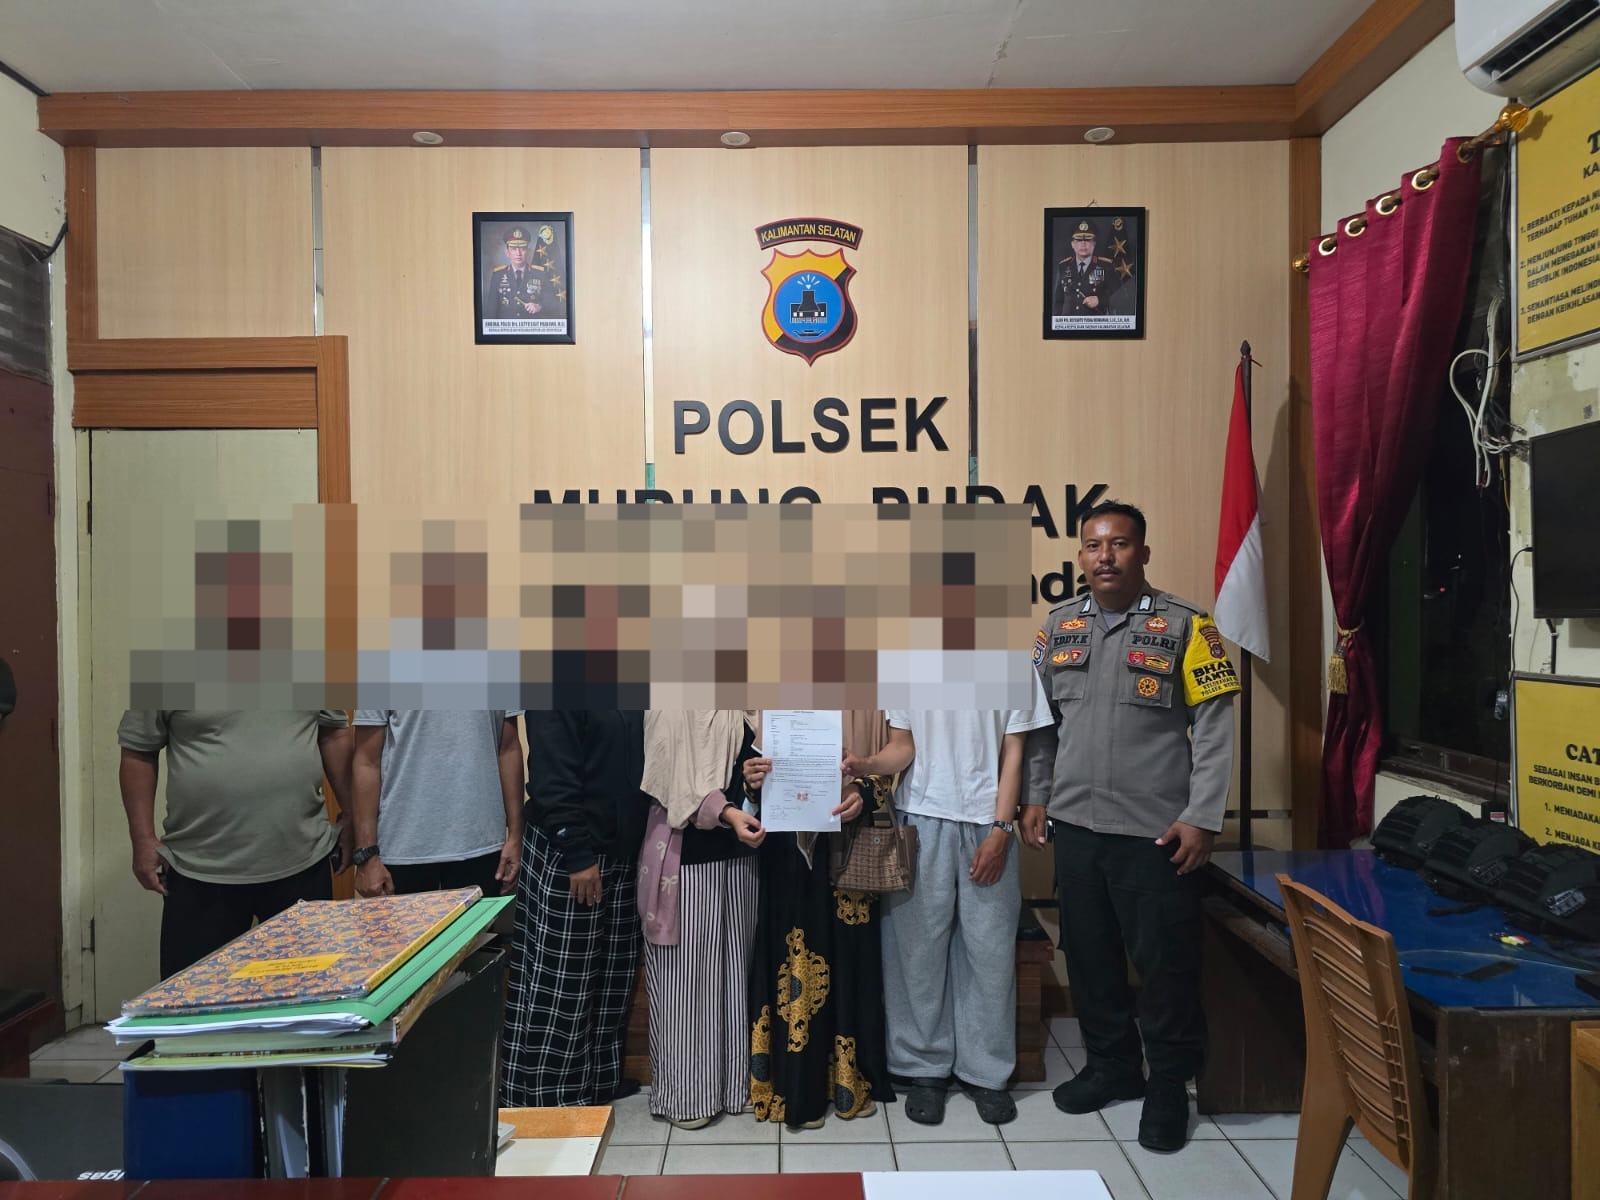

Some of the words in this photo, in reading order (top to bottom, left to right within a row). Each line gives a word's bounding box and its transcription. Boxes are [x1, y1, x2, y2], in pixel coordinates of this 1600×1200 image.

[1527, 208, 1560, 231] BERBAKTI
[1562, 194, 1590, 214] KEPADA
[761, 224, 816, 243] KALIMANTAN
[817, 224, 857, 242] SELATAN
[1527, 219, 1563, 242] TERHADAP
[1563, 208, 1588, 226] TUHAN
[1527, 239, 1573, 266] MENJUNJUNG
[1574, 228, 1598, 246] TINGGI
[1527, 261, 1551, 277] DALAM
[1527, 269, 1560, 289] REPUBLIK
[1527, 290, 1569, 313] SENANTIASA
[1527, 307, 1555, 325] DENGAN
[673, 396, 949, 455] POLSEK
[1132, 633, 1177, 649] POLRI
[1533, 764, 1566, 779] SEBAGAI
[1567, 771, 1592, 785] INSAN
[1528, 775, 1575, 793] BERKORBAN
[1577, 786, 1597, 799] DEMI
[1555, 829, 1591, 848] MENJAGA
